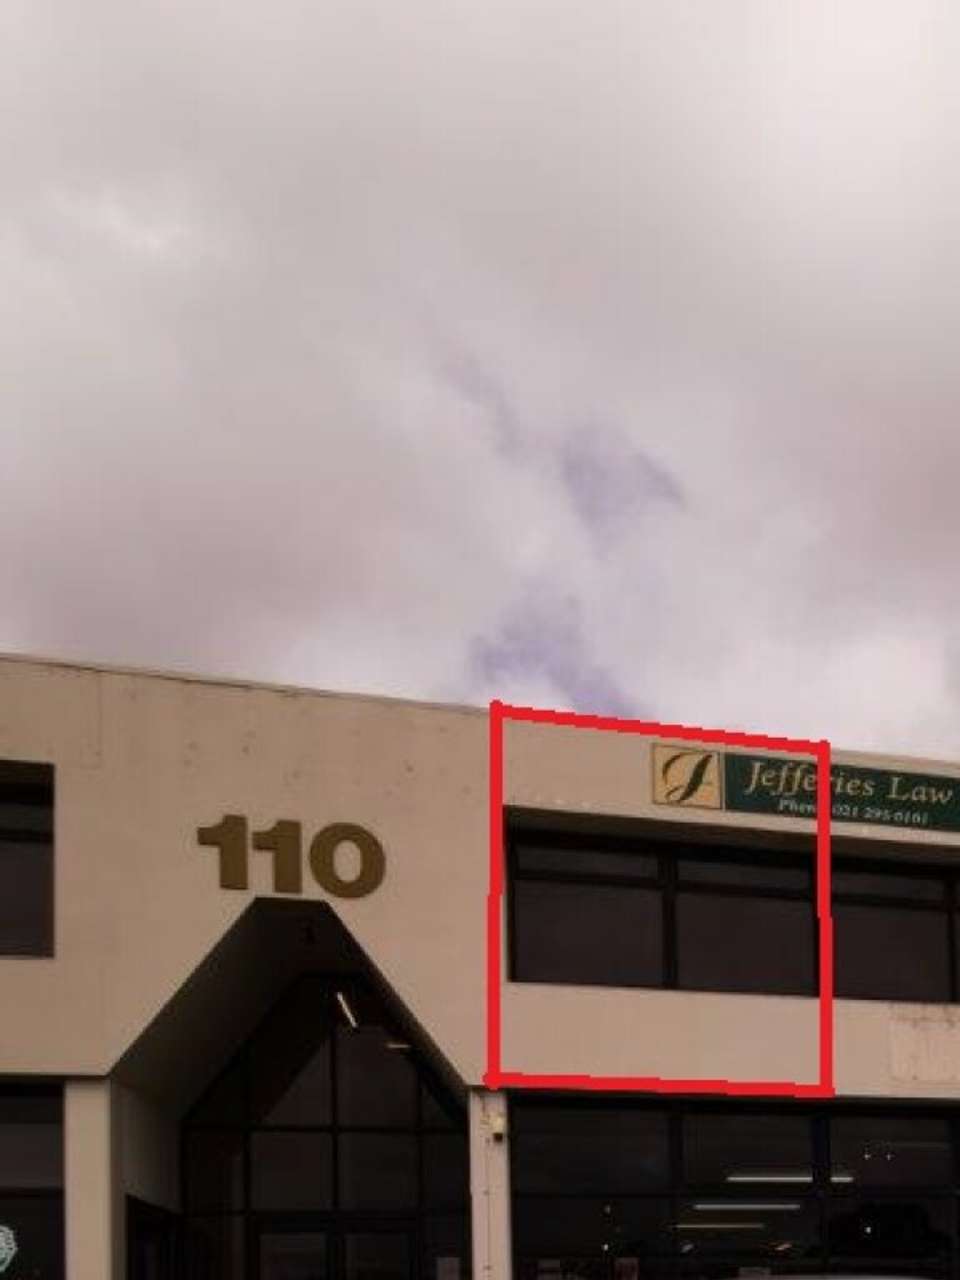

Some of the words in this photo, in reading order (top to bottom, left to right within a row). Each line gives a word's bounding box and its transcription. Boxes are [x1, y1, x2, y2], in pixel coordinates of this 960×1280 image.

[743, 761, 875, 797] Jeffeies
[886, 776, 953, 804] Law
[779, 799, 826, 814] Phon
[198, 815, 386, 899] 110
